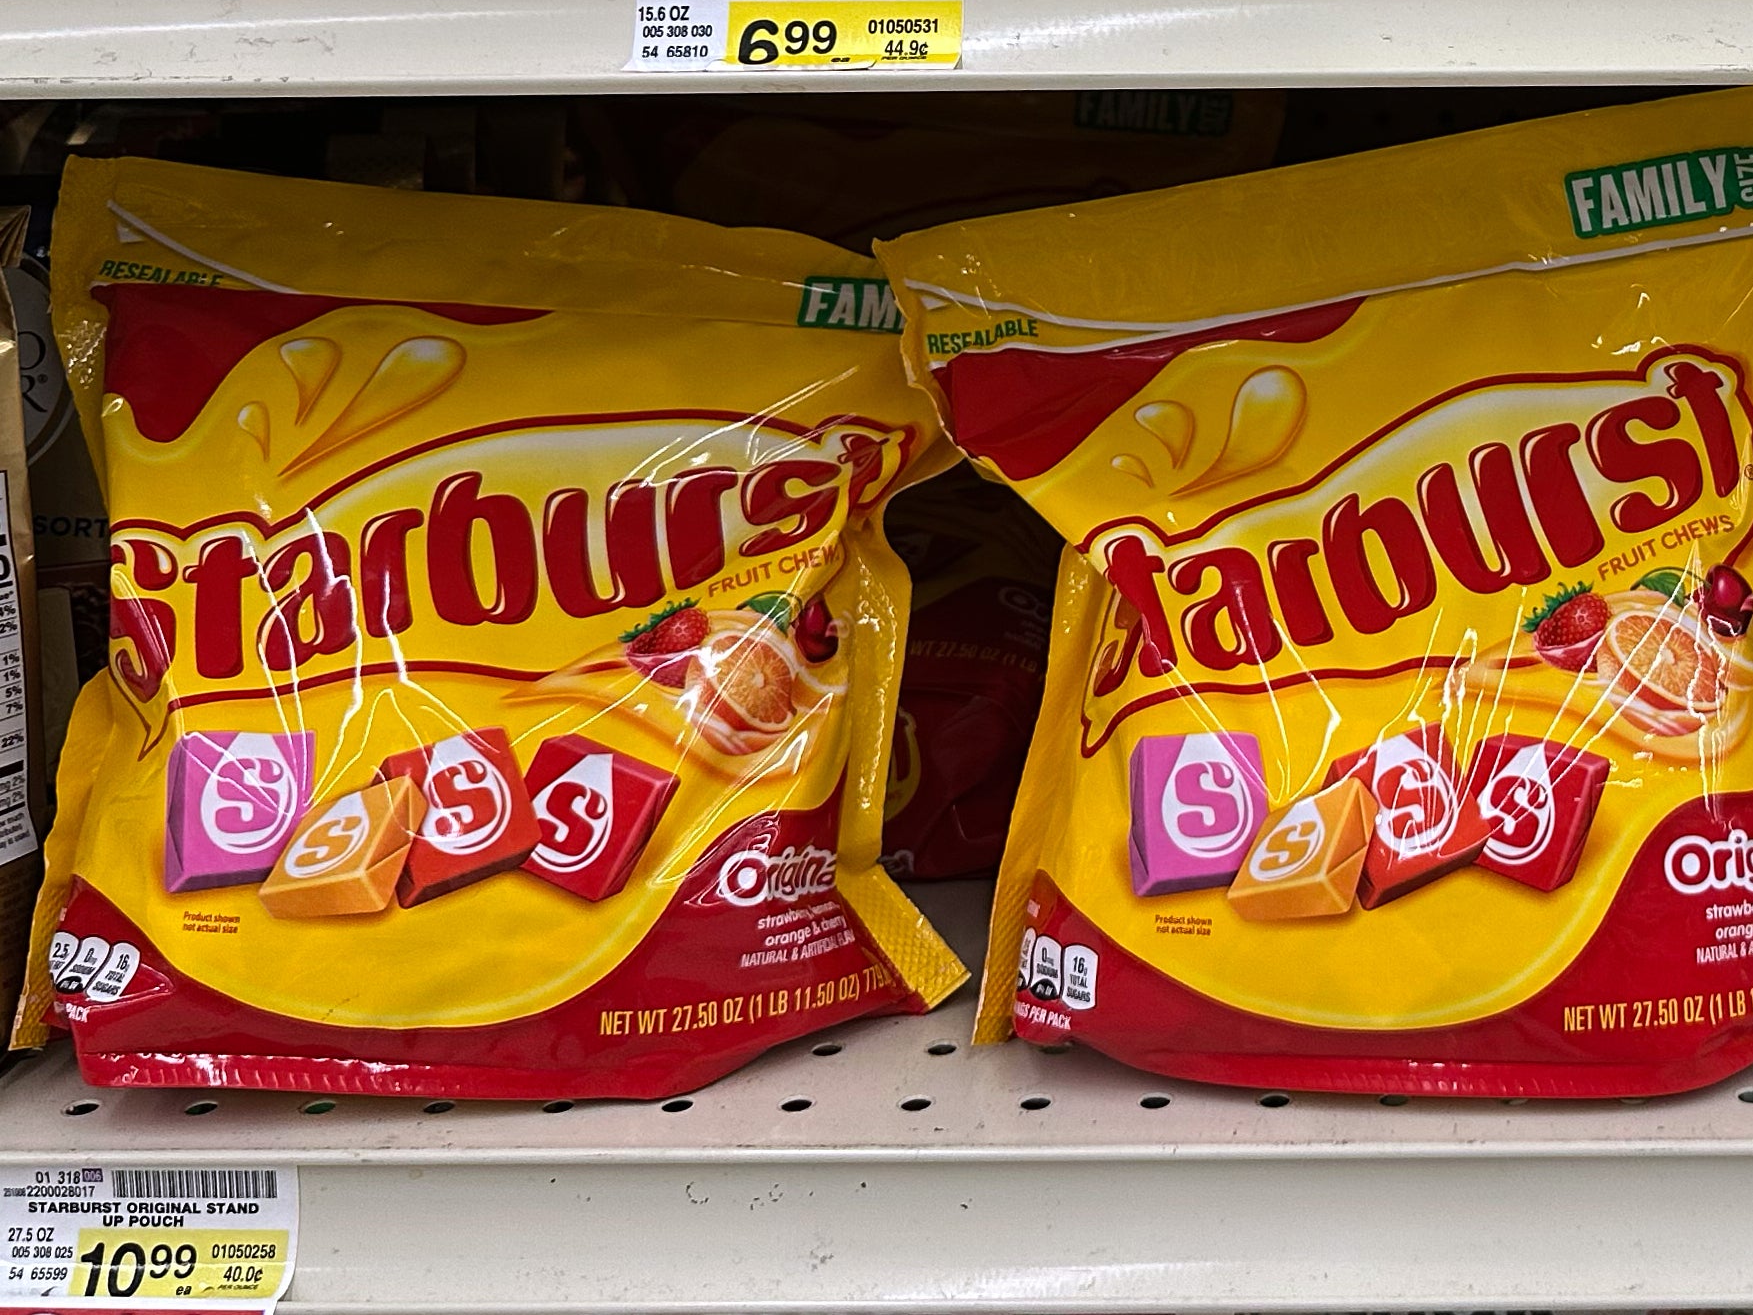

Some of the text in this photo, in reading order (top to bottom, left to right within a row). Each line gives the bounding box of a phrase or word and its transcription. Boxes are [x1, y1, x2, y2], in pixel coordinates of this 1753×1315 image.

[638, 7, 690, 21] 15.6 OZ
[868, 19, 939, 34] 01050531
[642, 46, 708, 59] 54 65810
[884, 40, 929, 56] 44.9¢
[1572, 153, 1729, 233] FAMILY
[927, 318, 1038, 355] RESEALABLE
[1597, 511, 1737, 582] FRUIT CHEWS
[109, 432, 889, 685] Starburst
[707, 568, 774, 598] FRUIT
[600, 985, 834, 1037] NET WT 27.50 OZ (1 LB 11.50
[26, 1186, 95, 1197] 2200028017
[28, 1202, 259, 1214] STARBURST ORIGINAL STAND
[103, 1216, 184, 1227] UP POUCH
[8, 1228, 54, 1242] 27.5 OZ
[212, 1244, 276, 1258] 01050258
[223, 1266, 263, 1282] 40.0¢
